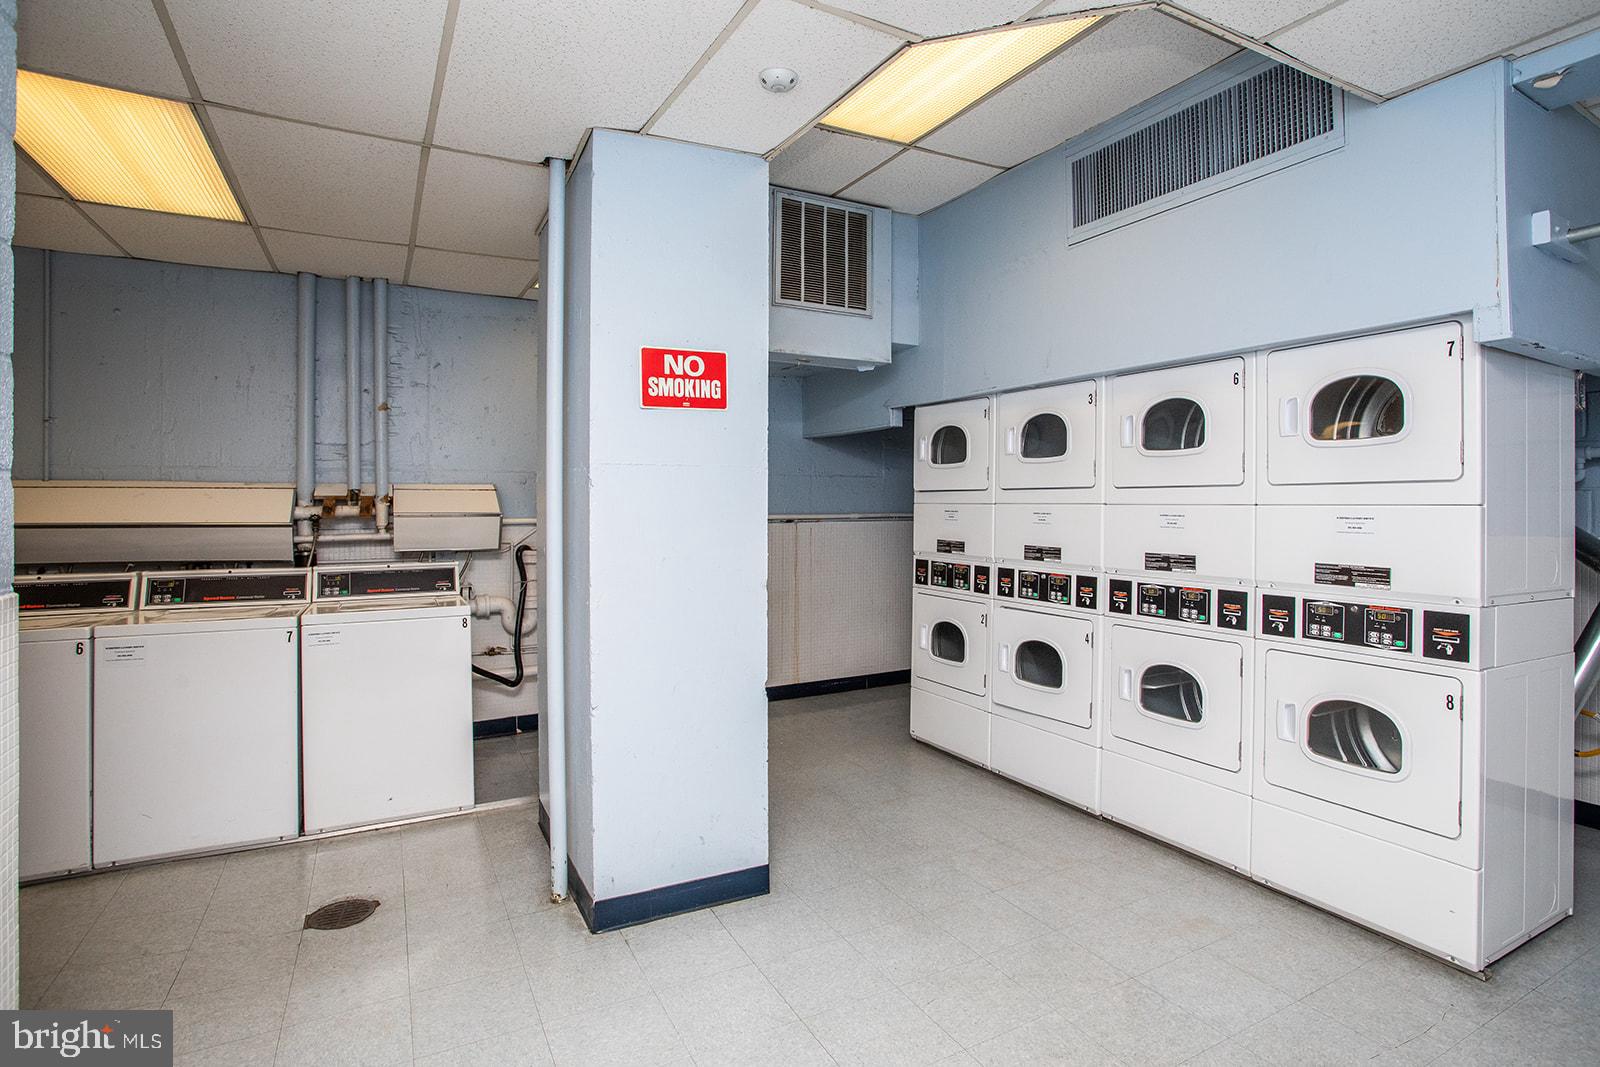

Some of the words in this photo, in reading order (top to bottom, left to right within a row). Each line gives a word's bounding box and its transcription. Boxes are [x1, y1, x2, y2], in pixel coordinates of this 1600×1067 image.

[1446, 340, 1455, 357] 7
[663, 353, 705, 377] NO
[1233, 372, 1240, 385] 6
[647, 376, 721, 399] SMOKING
[1088, 393, 1094, 405] 3
[462, 617, 468, 628] 8
[980, 614, 985, 625] 2
[286, 630, 293, 643] 7
[1084, 633, 1090, 645] 4
[76, 642, 84, 655] 6
[1446, 694, 1455, 711] 8
